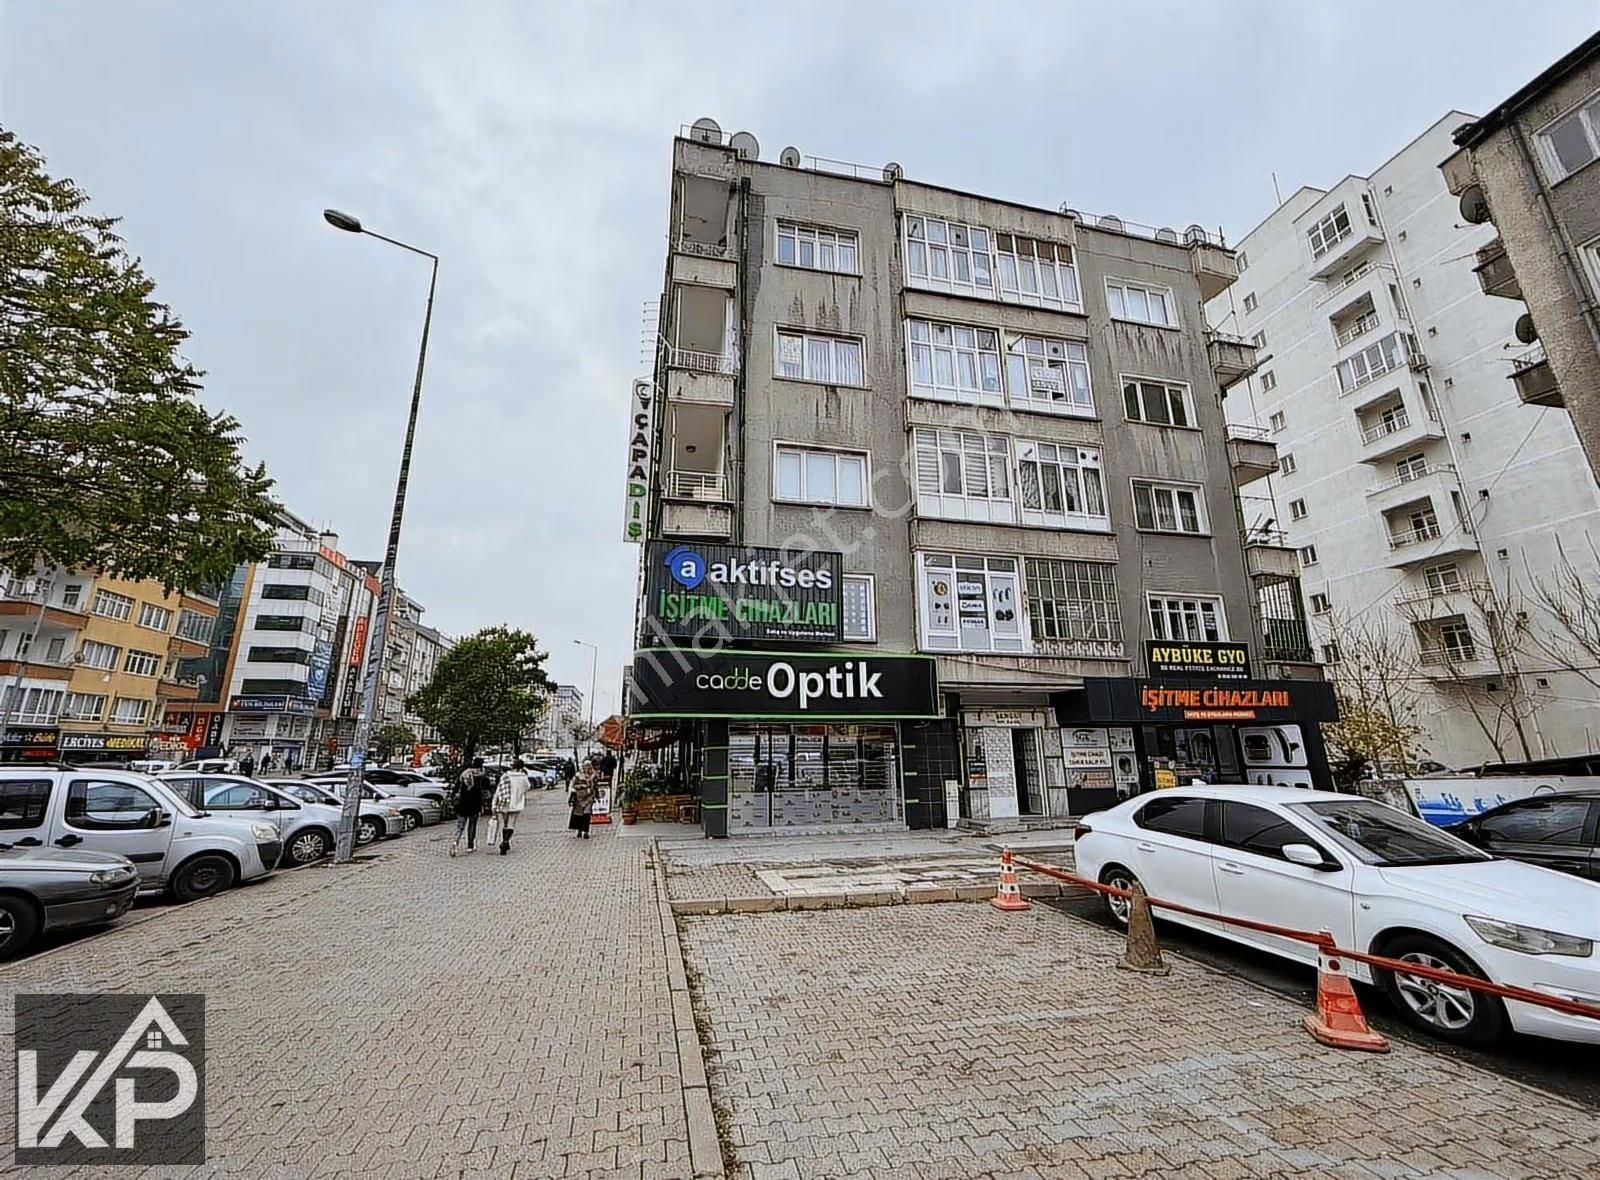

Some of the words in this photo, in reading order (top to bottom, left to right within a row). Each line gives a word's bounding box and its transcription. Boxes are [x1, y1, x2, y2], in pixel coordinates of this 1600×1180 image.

[710, 558, 832, 589] aktifses
[659, 589, 729, 623] İŞİTME
[734, 595, 837, 625] CİHAZLARI
[1152, 644, 1213, 664] AYBÜKE
[1218, 649, 1246, 665] GYO
[696, 667, 762, 690] cadde
[766, 661, 884, 709] Optik
[1142, 685, 1200, 712] İŞİTME
[1203, 686, 1289, 707] CİHAZLARI
